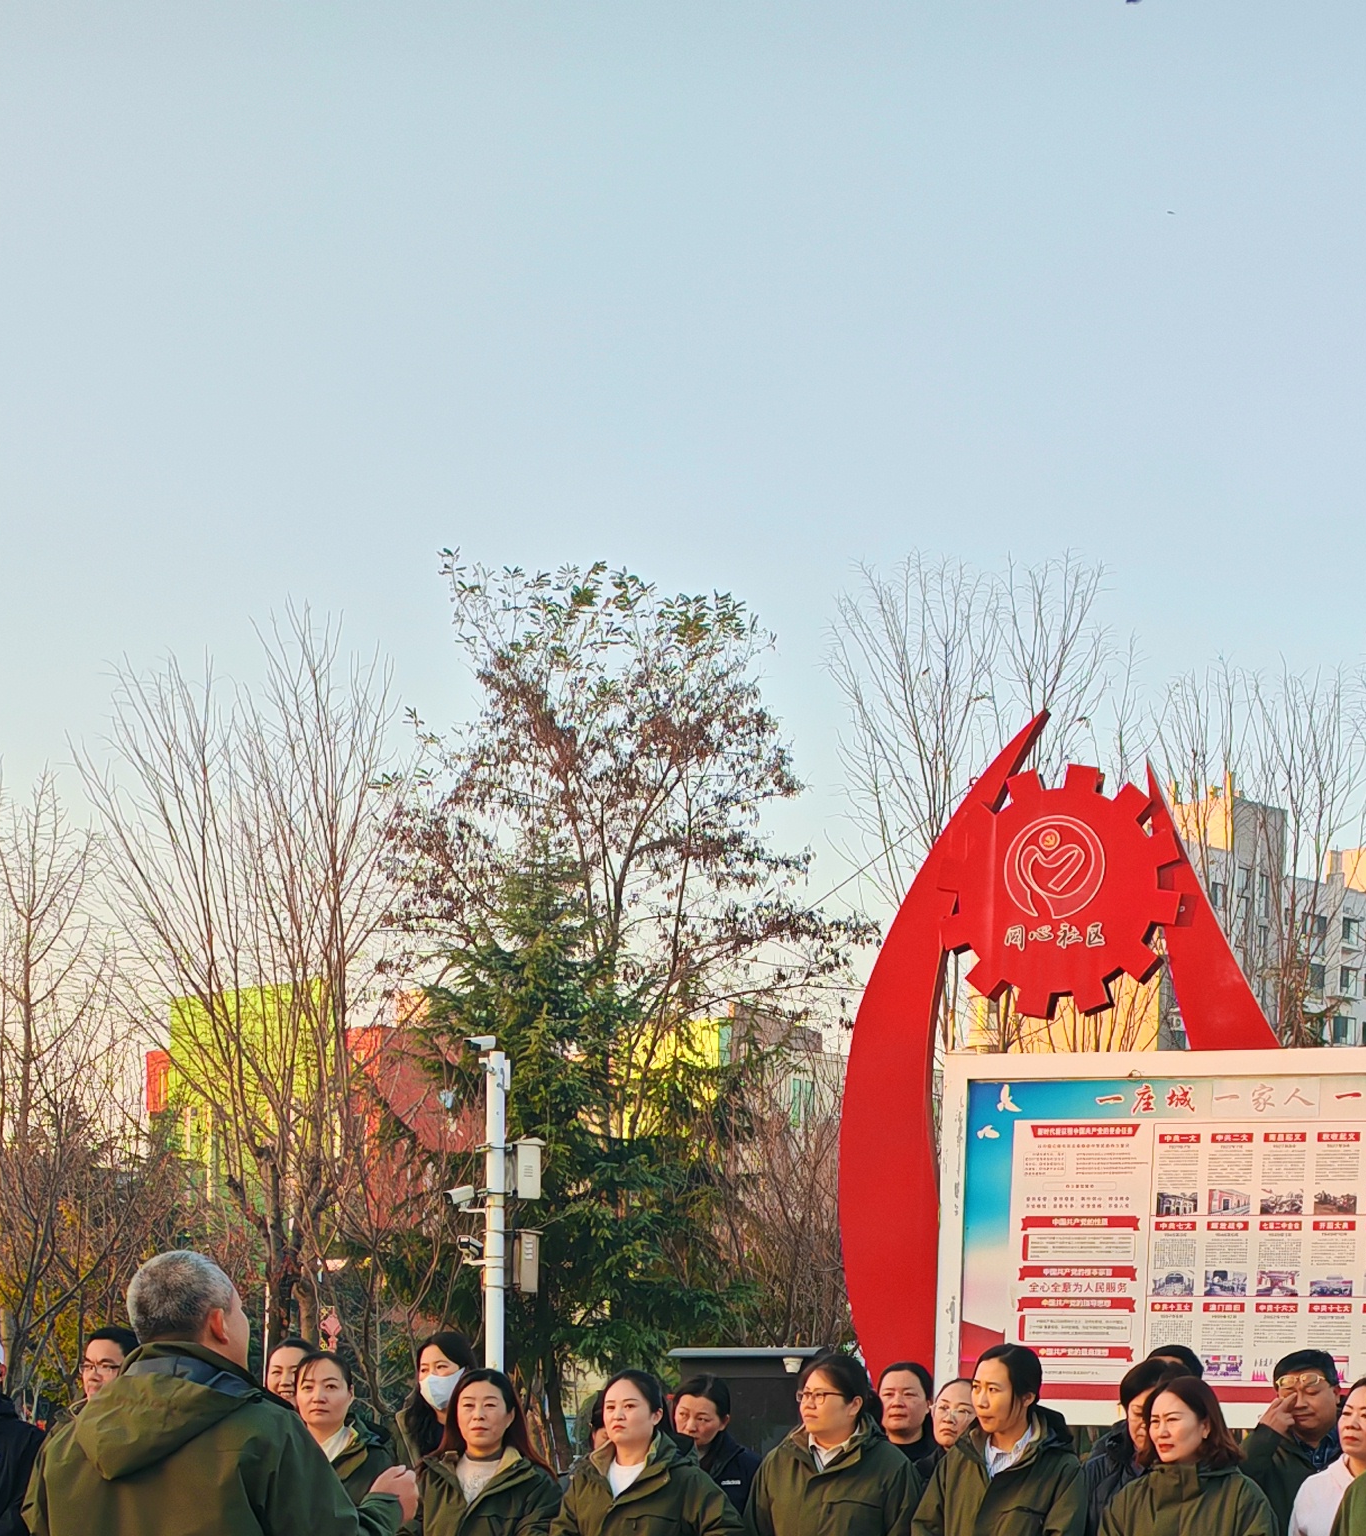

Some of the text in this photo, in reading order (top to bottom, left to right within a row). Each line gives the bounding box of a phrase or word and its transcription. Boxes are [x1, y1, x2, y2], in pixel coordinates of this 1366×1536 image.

[1004, 922, 1106, 951] 同心社区
[1096, 1084, 1197, 1115] 一座城
[1214, 1083, 1315, 1112] 一家人
[1028, 1282, 1128, 1293] 全心全意为人民服务
